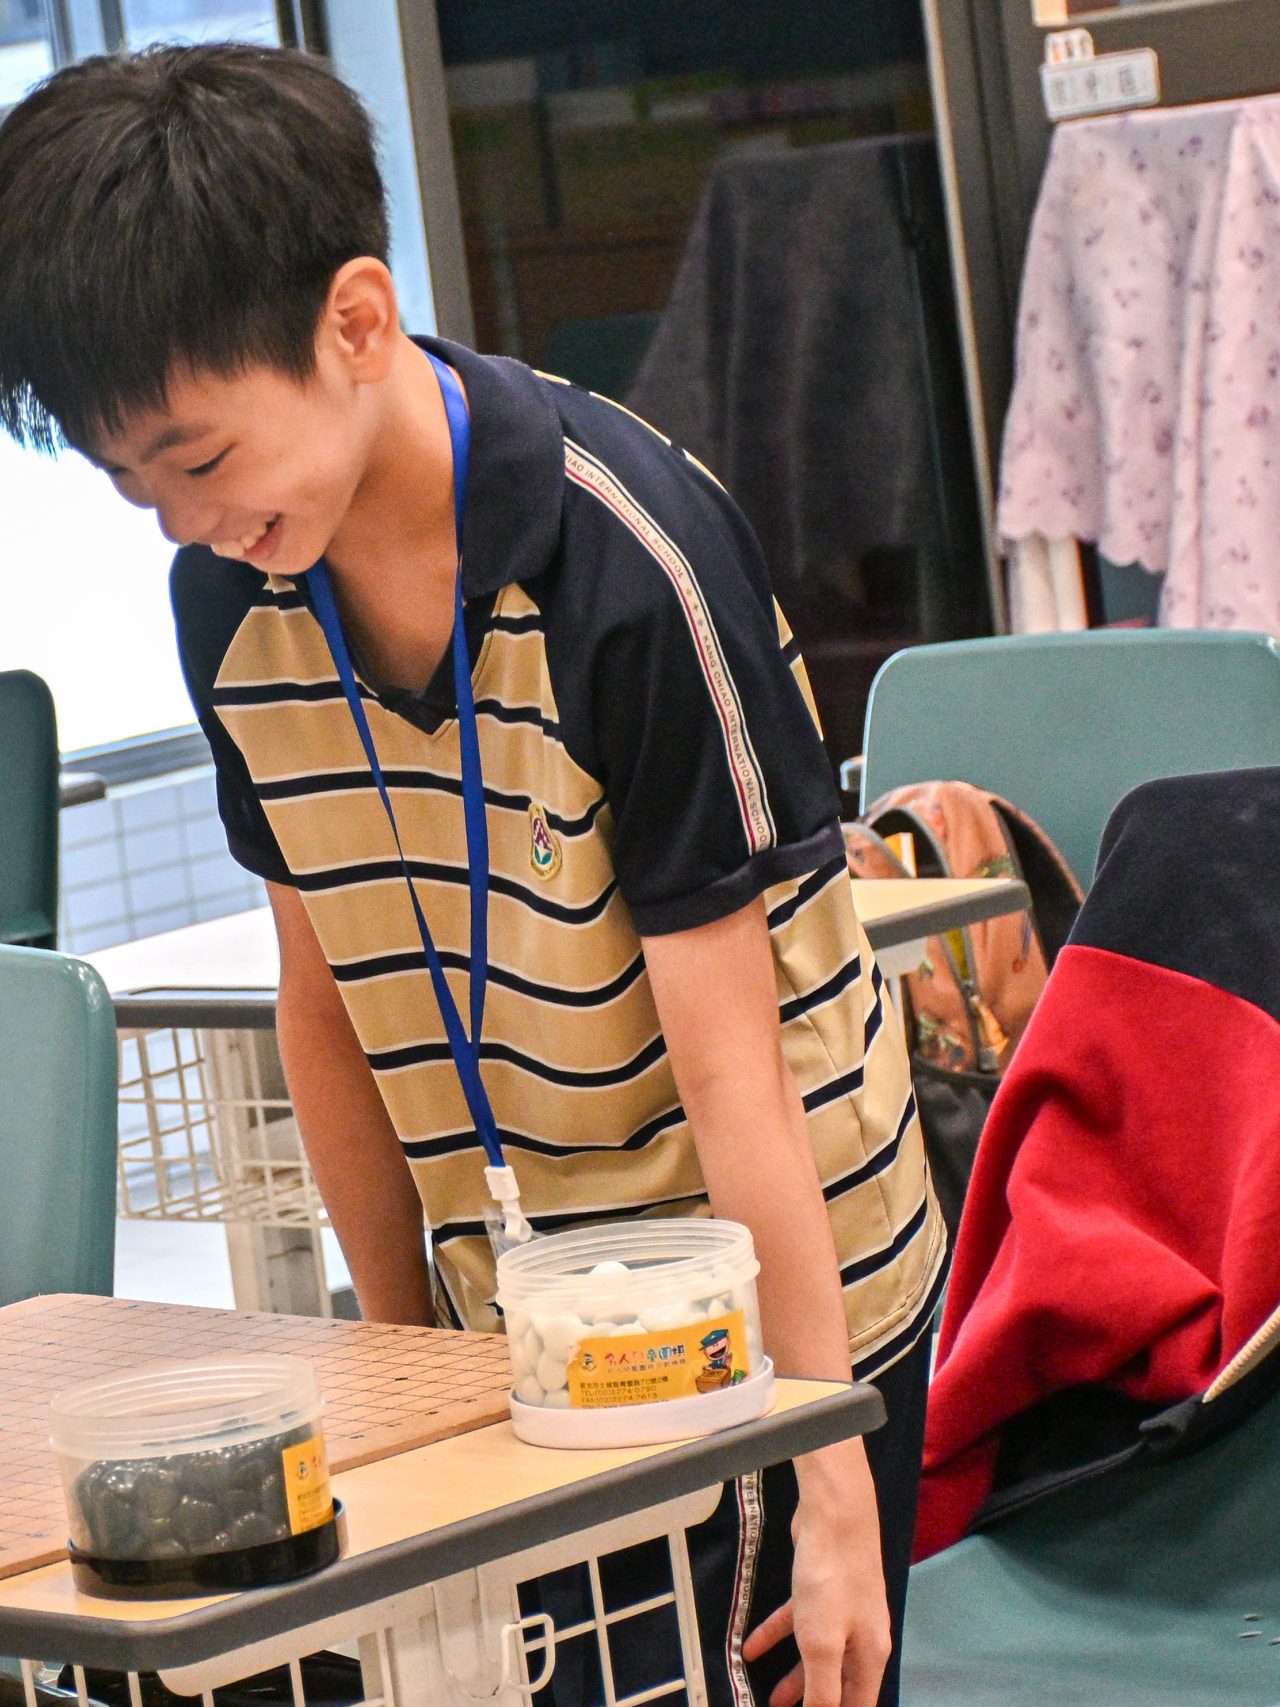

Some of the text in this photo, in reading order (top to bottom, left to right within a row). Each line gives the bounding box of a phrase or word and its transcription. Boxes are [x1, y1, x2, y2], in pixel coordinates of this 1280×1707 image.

[584, 469, 651, 536] INTERNATIONAL
[652, 538, 685, 580] SCHOOL
[702, 634, 717, 668] KANG
[713, 671, 732, 707] CHIAO
[727, 710, 755, 798] INTERNATIONAL
